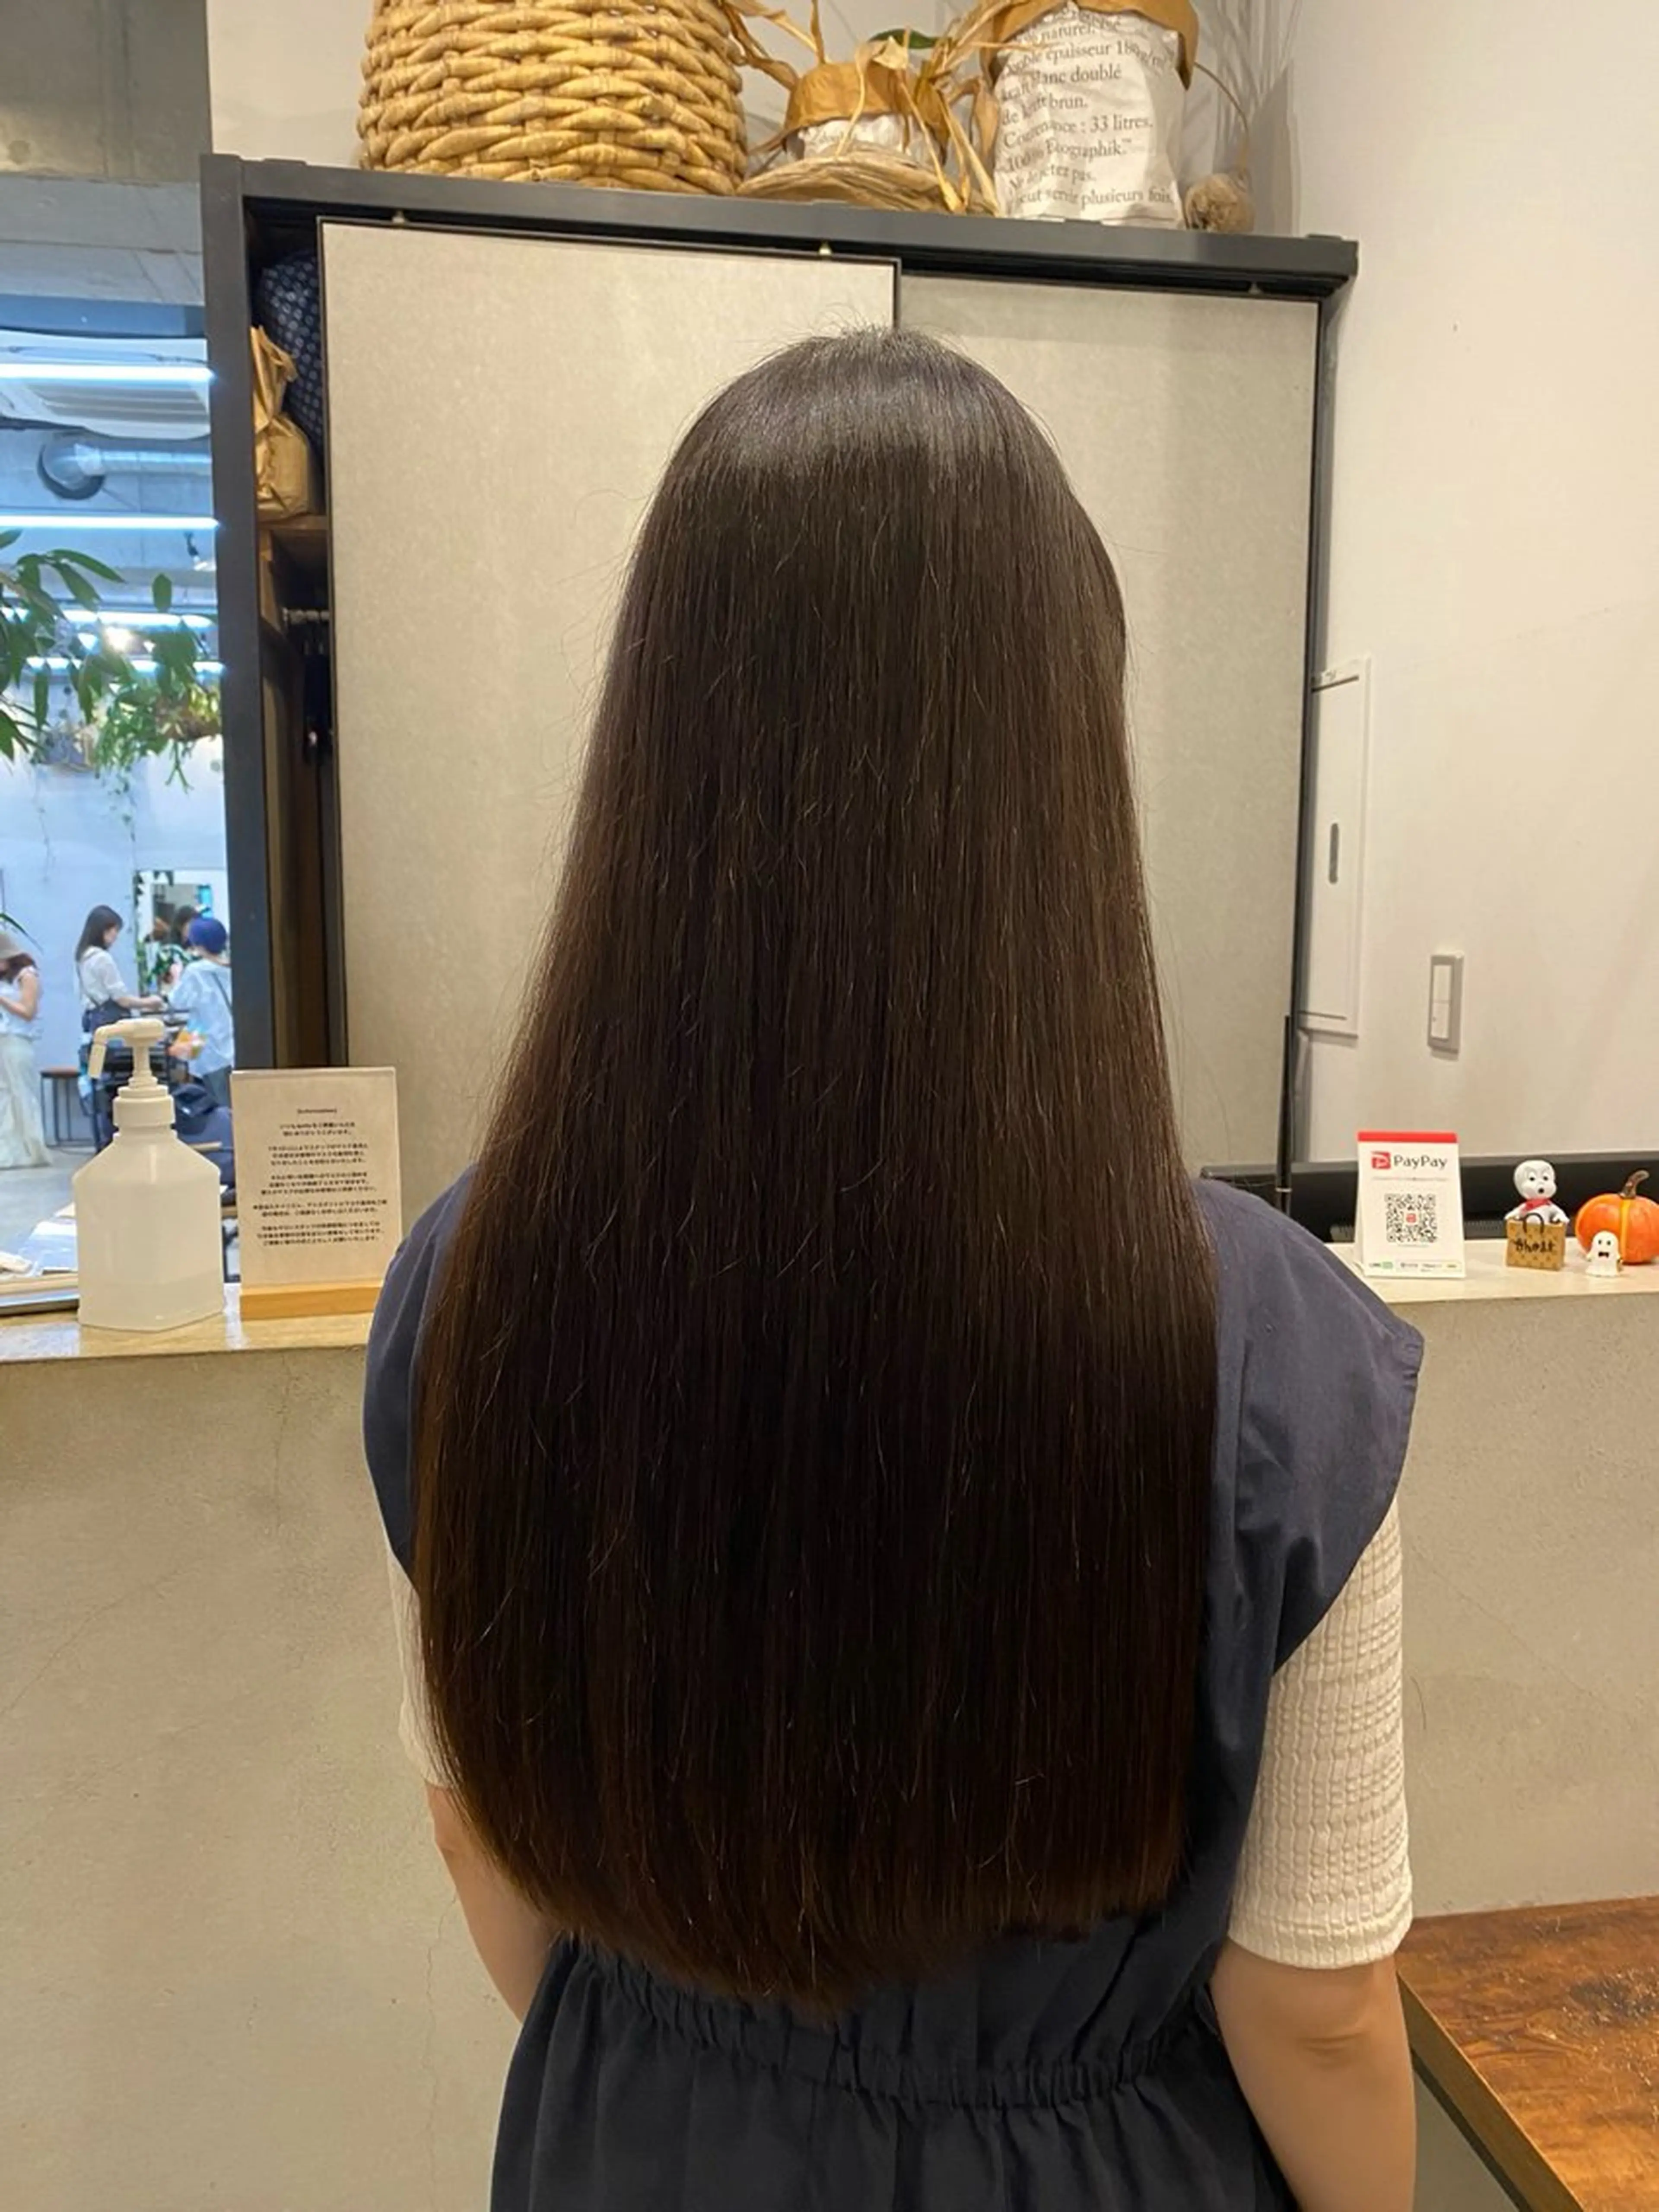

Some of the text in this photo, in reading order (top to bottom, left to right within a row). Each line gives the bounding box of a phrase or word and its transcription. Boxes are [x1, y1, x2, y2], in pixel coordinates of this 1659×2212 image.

[1049, 92, 1088, 110] brun.
[1090, 115, 1109, 133] 33
[1113, 113, 1154, 131] litres.
[1394, 1154, 1448, 1171] PayPay
